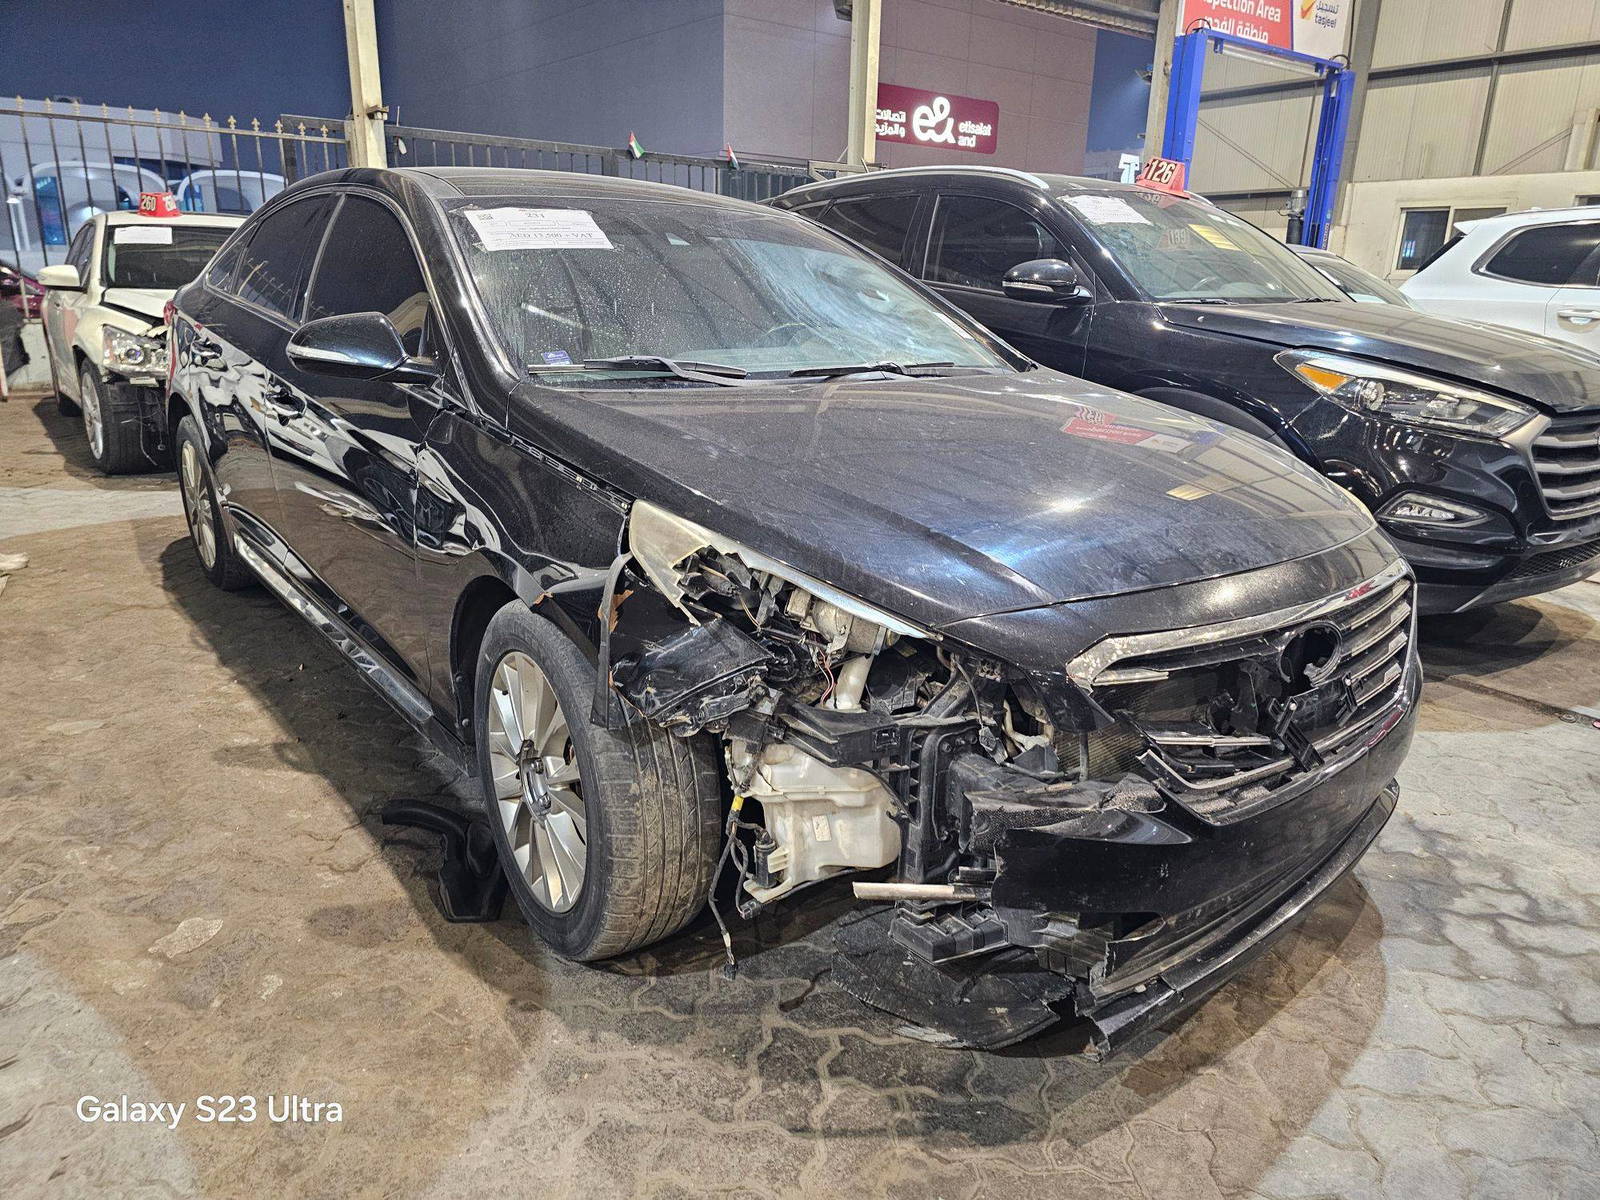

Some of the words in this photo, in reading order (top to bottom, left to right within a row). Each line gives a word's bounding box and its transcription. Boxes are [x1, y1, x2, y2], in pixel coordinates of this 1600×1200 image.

[1256, 1, 1281, 22] Area
[1315, 13, 1337, 28] tasjeel
[958, 120, 992, 136] etisalat
[957, 134, 976, 147] and
[1146, 159, 1177, 184] 126
[141, 194, 157, 211] 260
